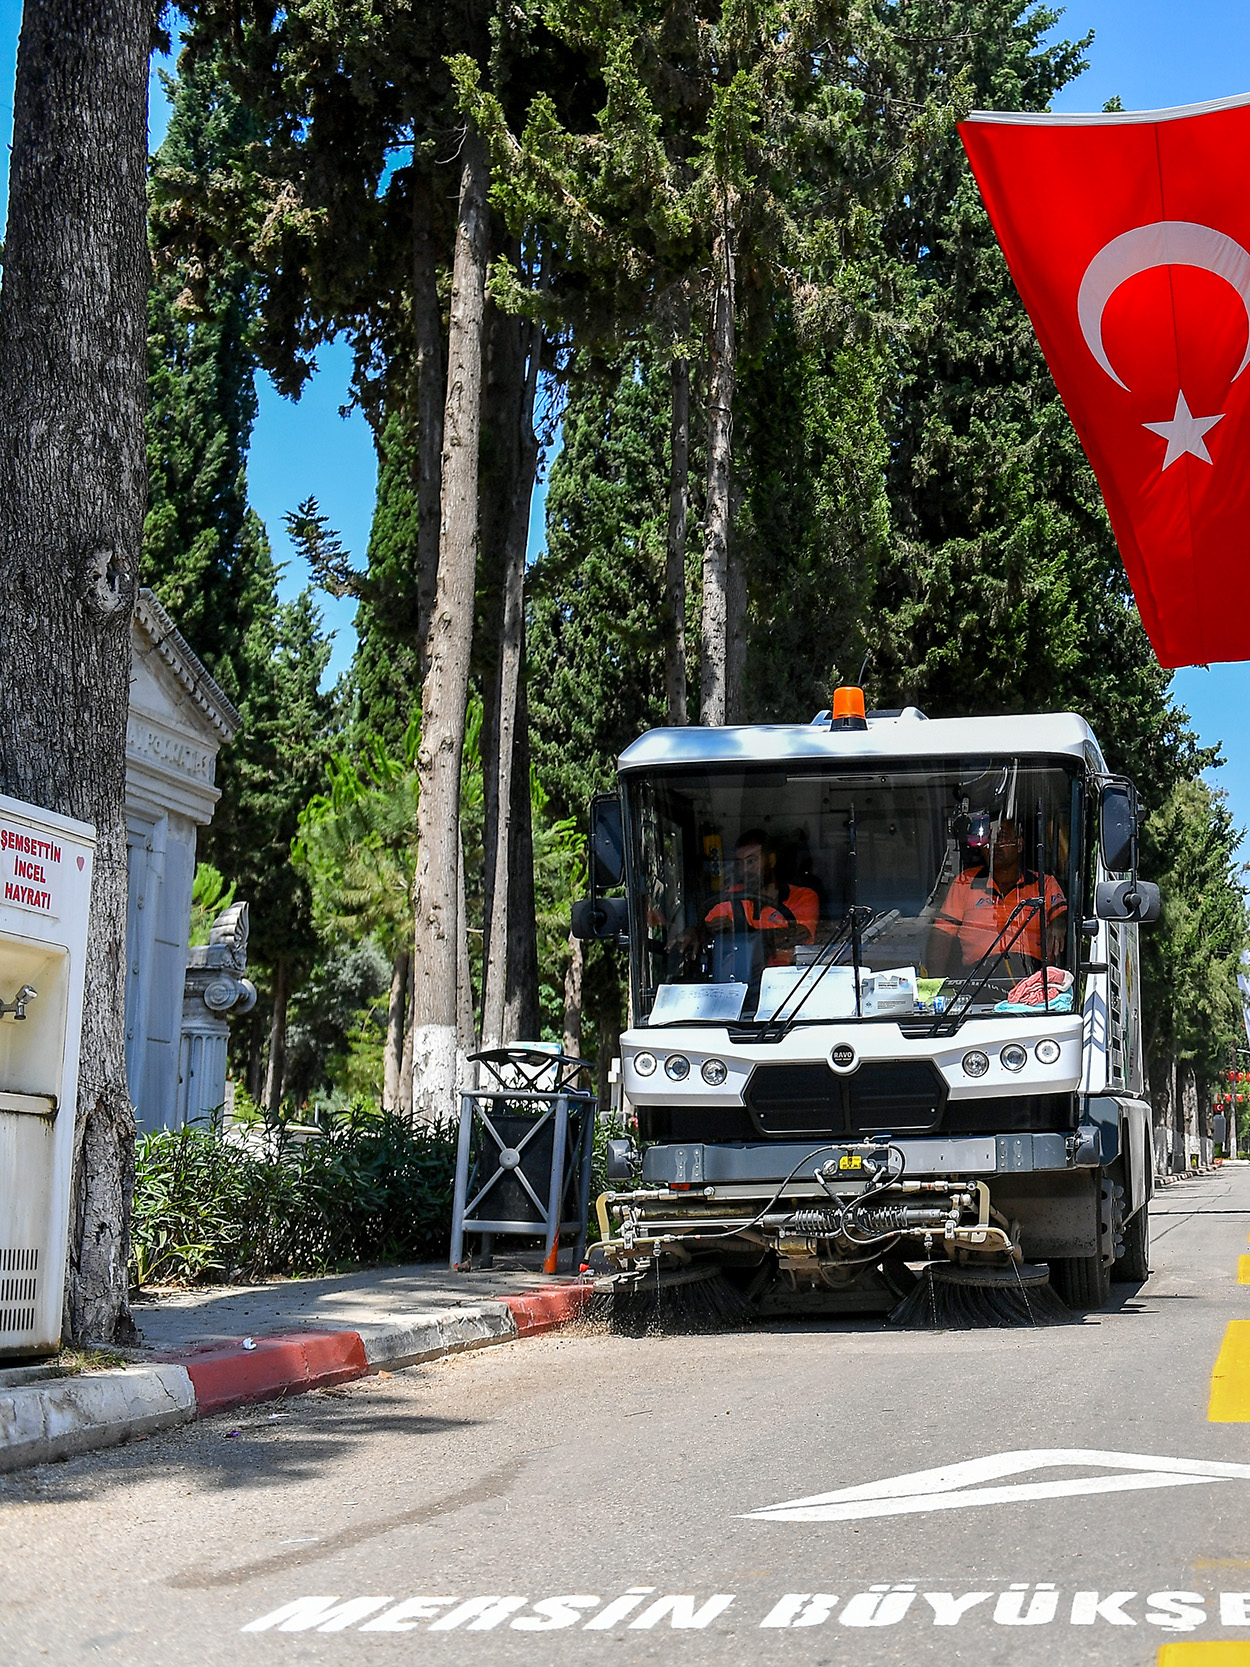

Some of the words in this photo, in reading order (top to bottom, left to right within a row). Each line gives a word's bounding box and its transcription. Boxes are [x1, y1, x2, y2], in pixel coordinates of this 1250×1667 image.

[0, 829, 62, 863] ŞEMSETTİN
[14, 855, 46, 883] İNCEL
[4, 881, 51, 909] HAYRATI
[834, 1051, 852, 1059] RAVO
[240, 1586, 736, 1633] MERSİN
